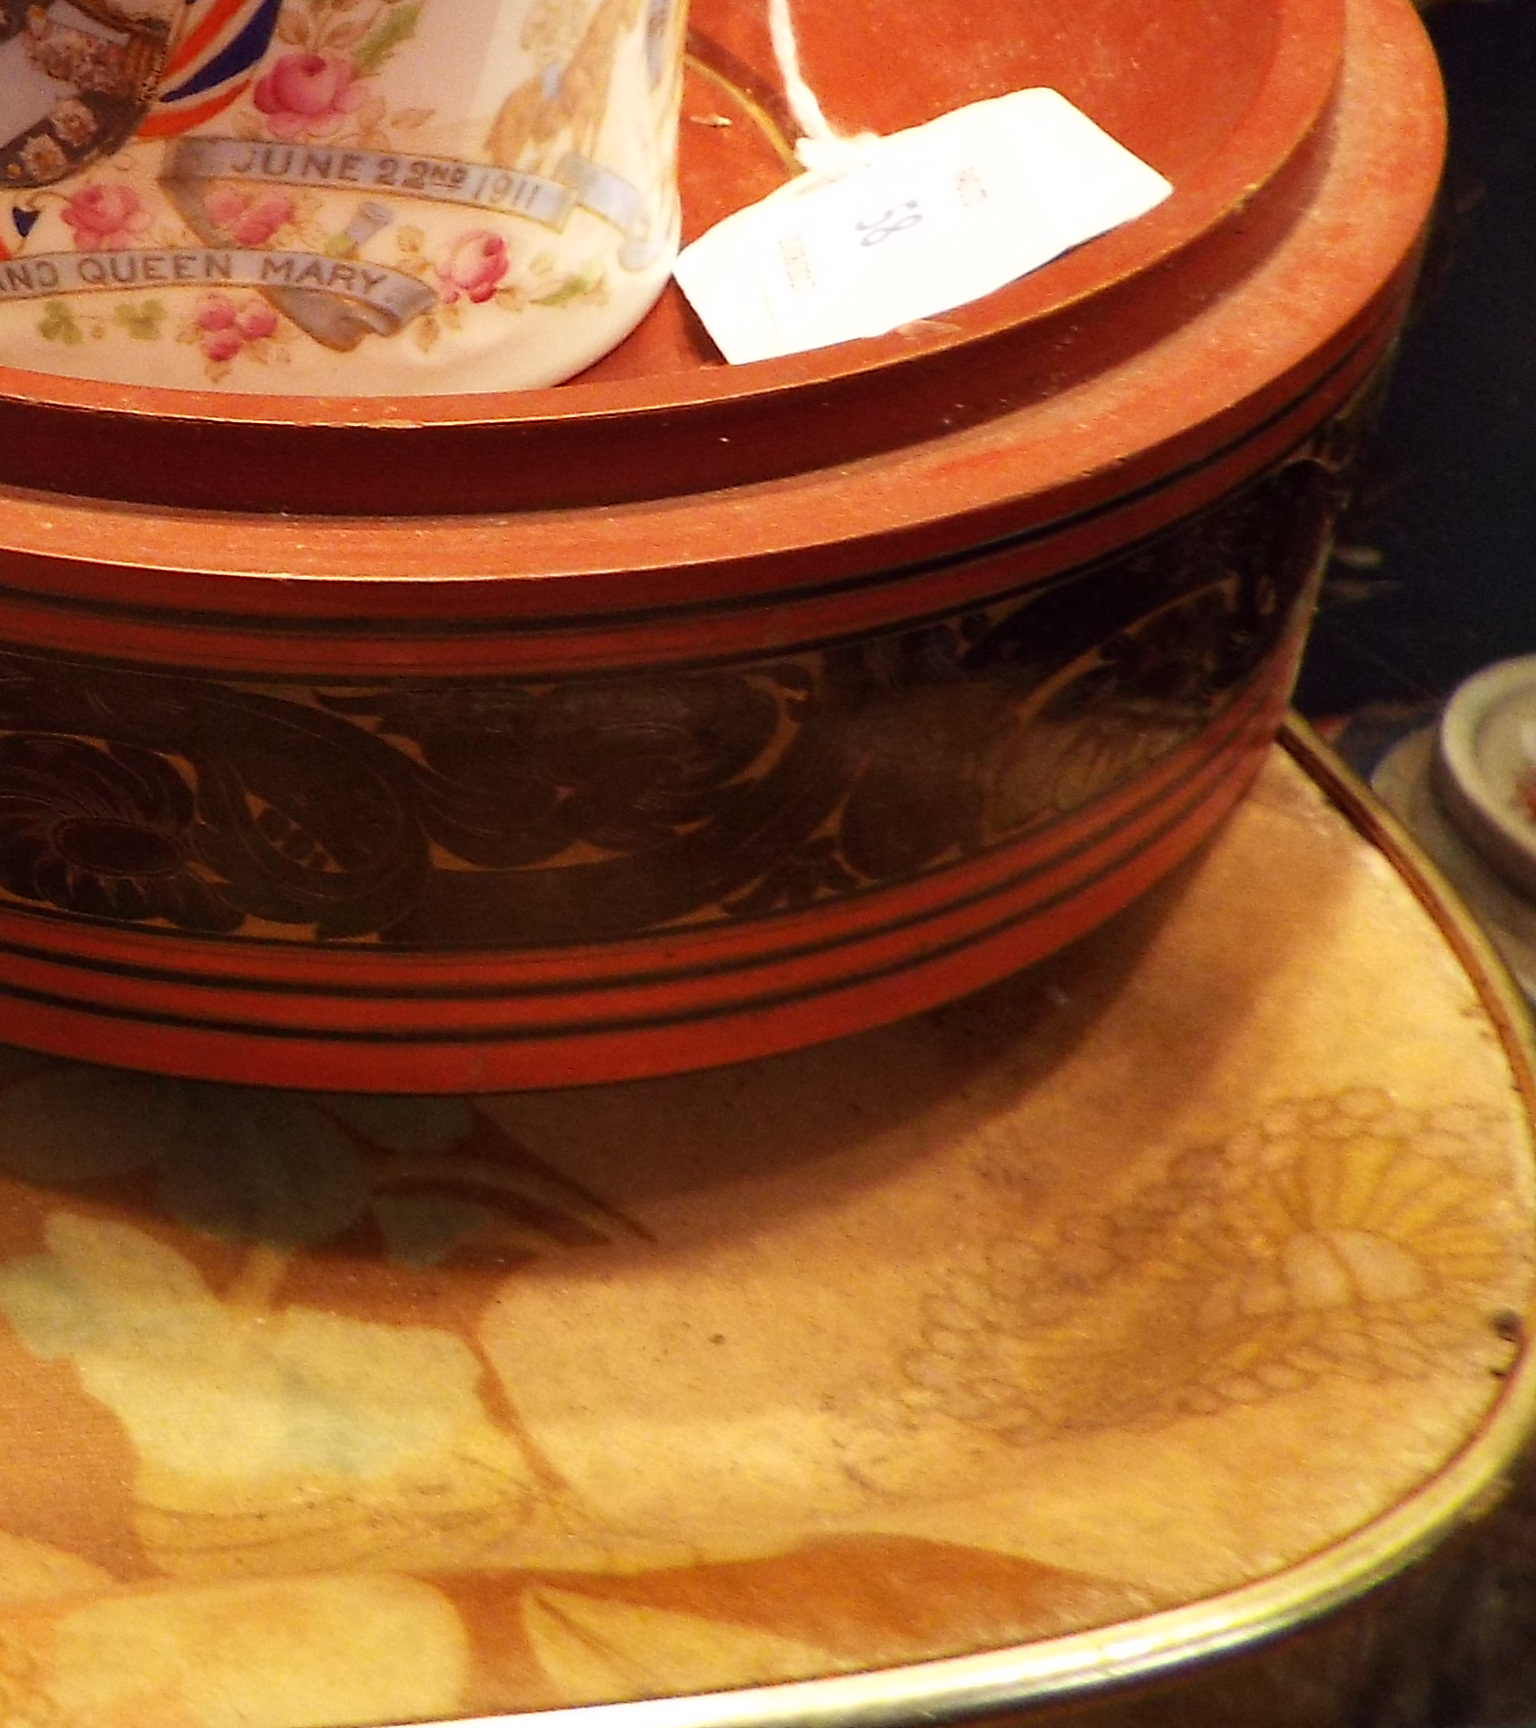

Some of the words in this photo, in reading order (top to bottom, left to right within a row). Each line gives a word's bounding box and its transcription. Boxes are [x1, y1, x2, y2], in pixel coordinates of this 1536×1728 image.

[231, 148, 364, 183] JUNE
[475, 174, 541, 209] 1911
[77, 253, 233, 289] QUEEN
[262, 255, 389, 294] MARY
